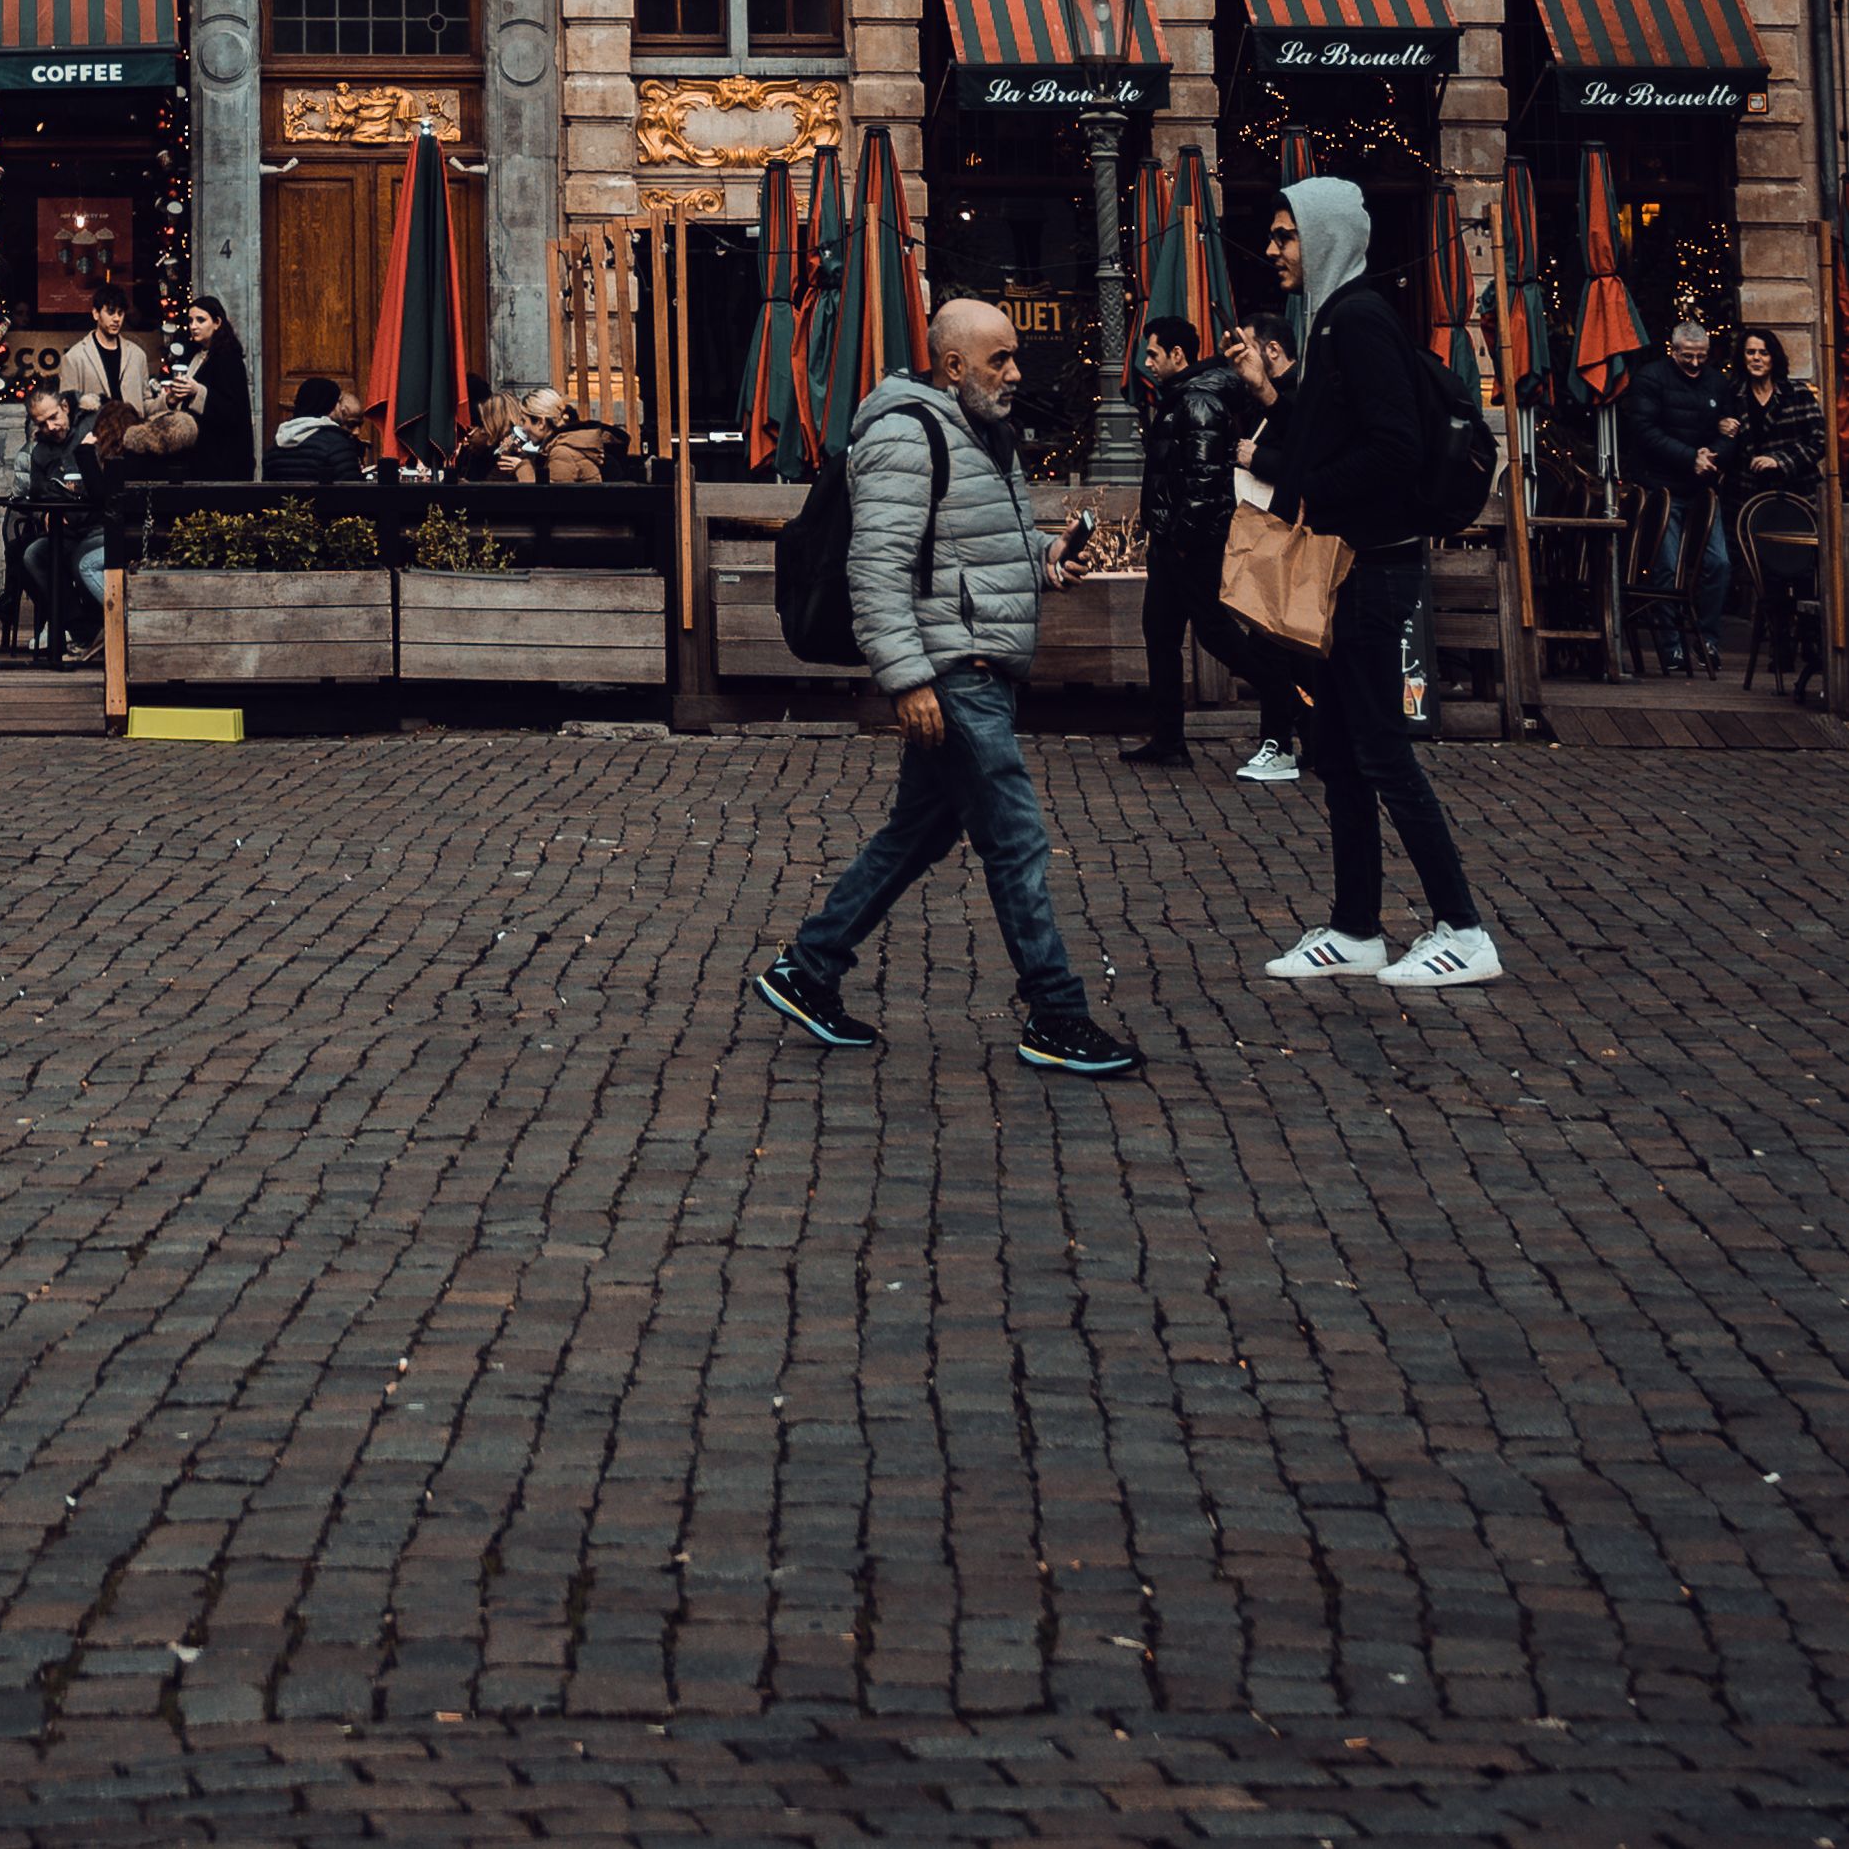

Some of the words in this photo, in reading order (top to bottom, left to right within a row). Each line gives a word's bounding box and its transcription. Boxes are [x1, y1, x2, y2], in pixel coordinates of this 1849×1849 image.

[1276, 40, 1317, 65] La
[1320, 42, 1436, 66] Brouette
[31, 63, 123, 83] COFFEE
[984, 78, 1026, 103] La
[1028, 79, 1144, 104] Broute
[1580, 81, 1623, 106] La
[1625, 82, 1742, 106] Brouette
[219, 238, 232, 259] 4
